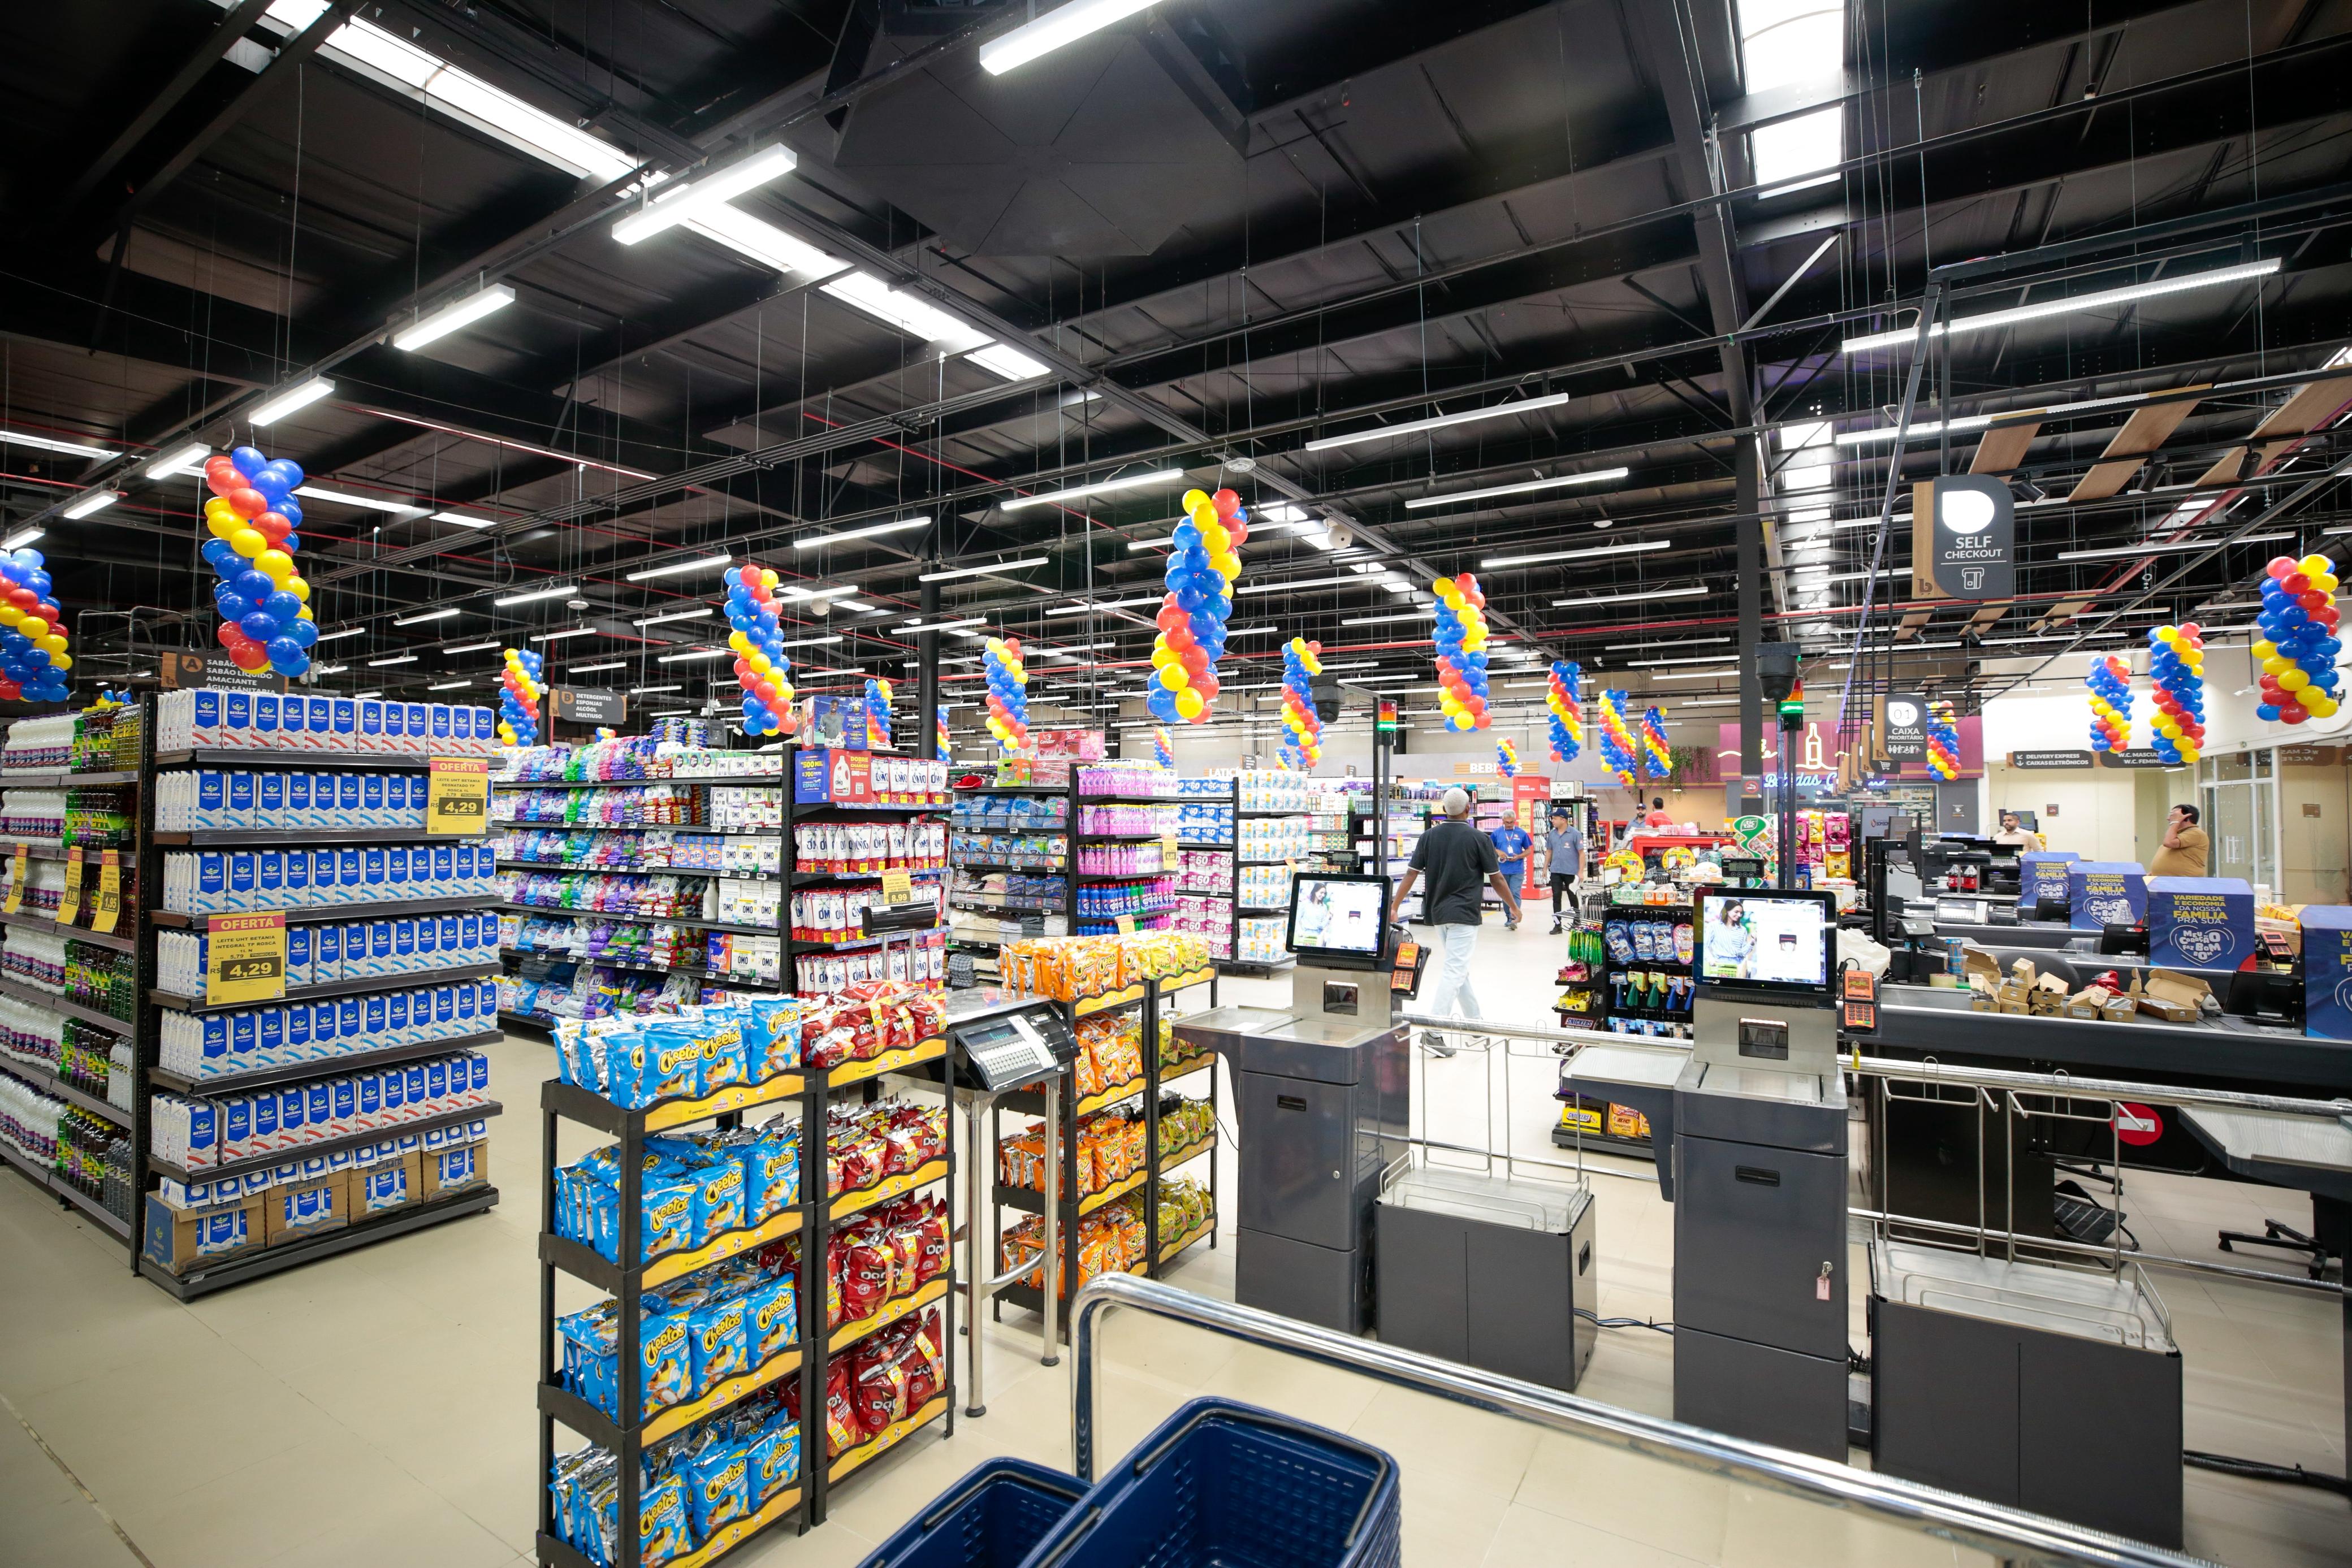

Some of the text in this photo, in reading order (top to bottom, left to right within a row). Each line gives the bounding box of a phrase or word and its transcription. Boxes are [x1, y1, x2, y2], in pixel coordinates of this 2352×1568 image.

[1956, 536, 1992, 549] SELF
[1945, 549, 2003, 559] CHECKOUT
[206, 675, 258, 686] AMACIANTE
[1894, 709, 1910, 719] 01
[439, 763, 480, 772] OFERTA
[444, 802, 477, 813] 4,29
[726, 851, 736, 859] OMO
[1197, 876, 1210, 885] 60
[104, 895, 117, 909] 1,95
[892, 894, 907, 902] 8,99
[723, 903, 733, 912] OMO
[742, 906, 753, 914] OMO
[1216, 903, 1229, 912] 60
[2173, 910, 2228, 920] FAMILIA
[220, 918, 275, 930] OFERTA
[1212, 944, 1224, 953] 60
[737, 956, 748, 965] OMO
[762, 958, 773, 967] OMO
[230, 962, 272, 978] 4,29
[768, 1009, 799, 1034] Cheetos
[1566, 1018, 1593, 1027] SNICKERS
[703, 1030, 741, 1059] Cheetos
[758, 1292, 792, 1330] Cheetos
[776, 1307, 793, 1320] ASSADO
[703, 1312, 742, 1352] Cheetos
[723, 1328, 740, 1341] ASSADO
[645, 1324, 686, 1367] Cheetos
[664, 1340, 685, 1355] ASSADO
[763, 1441, 793, 1478] Cheetos
[777, 1453, 793, 1468] ASSADO
[706, 1459, 746, 1501] Cheetos
[640, 1491, 678, 1536] Cheetos
